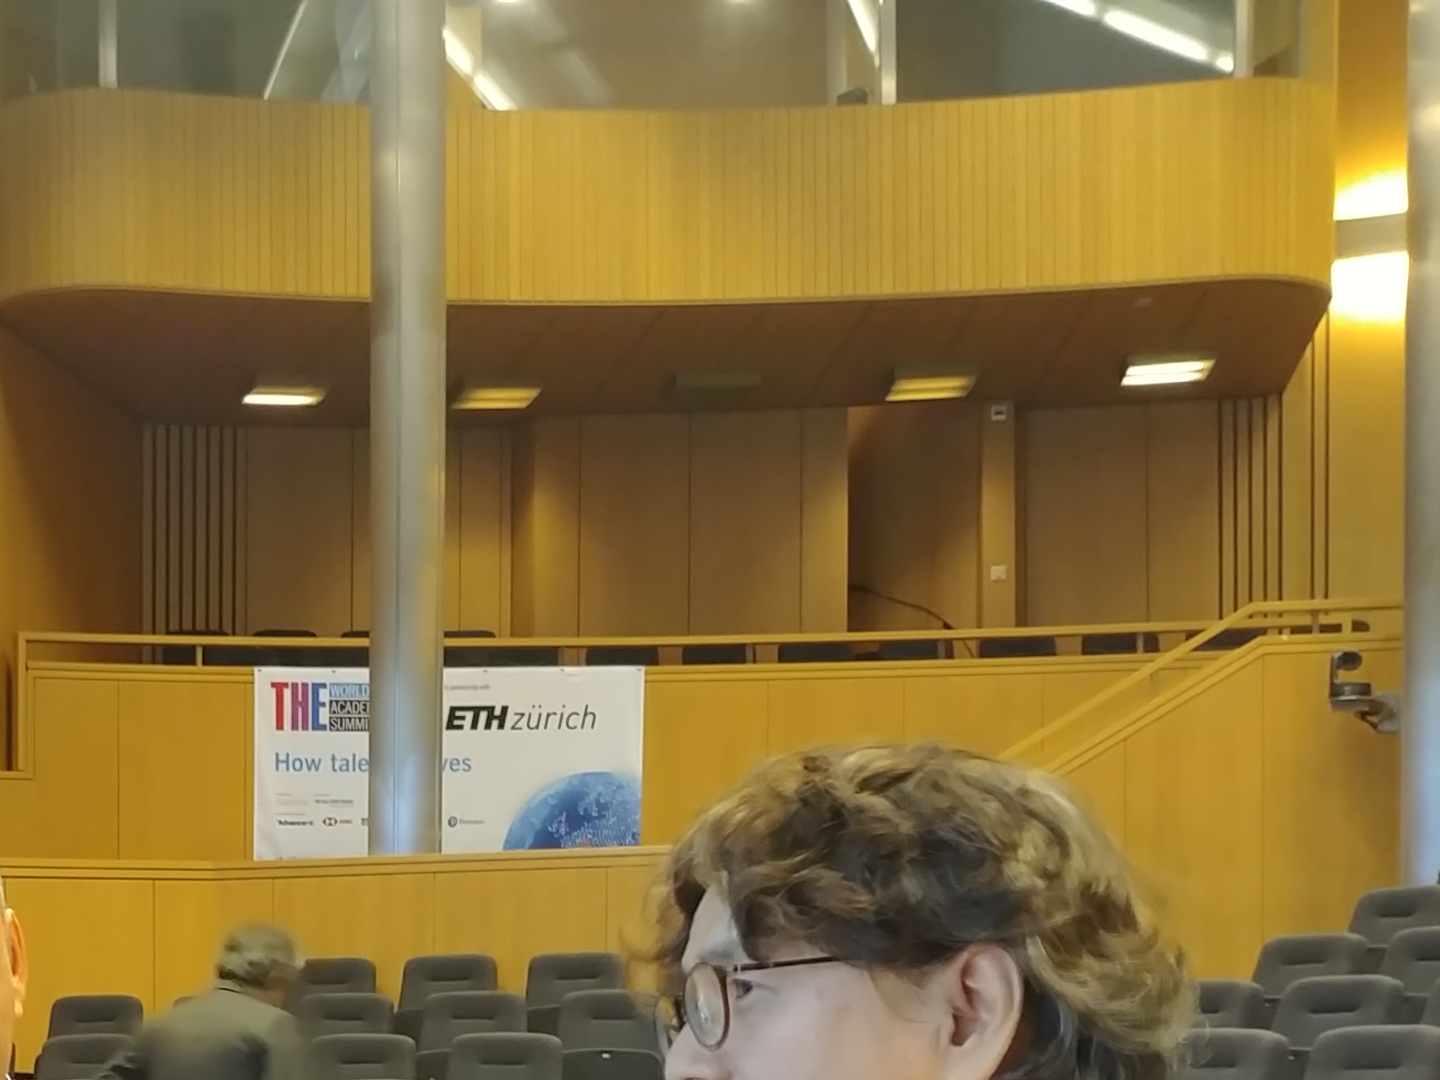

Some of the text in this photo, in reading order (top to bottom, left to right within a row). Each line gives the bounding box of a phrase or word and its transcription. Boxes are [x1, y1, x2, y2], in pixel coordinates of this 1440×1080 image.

[330, 684, 369, 697] WORLD
[271, 682, 327, 731] THE
[330, 702, 369, 714] ACADE
[330, 718, 368, 731] SUMMI
[445, 704, 597, 731] ETH zürich
[275, 752, 322, 772] How
[330, 753, 369, 772] tale
